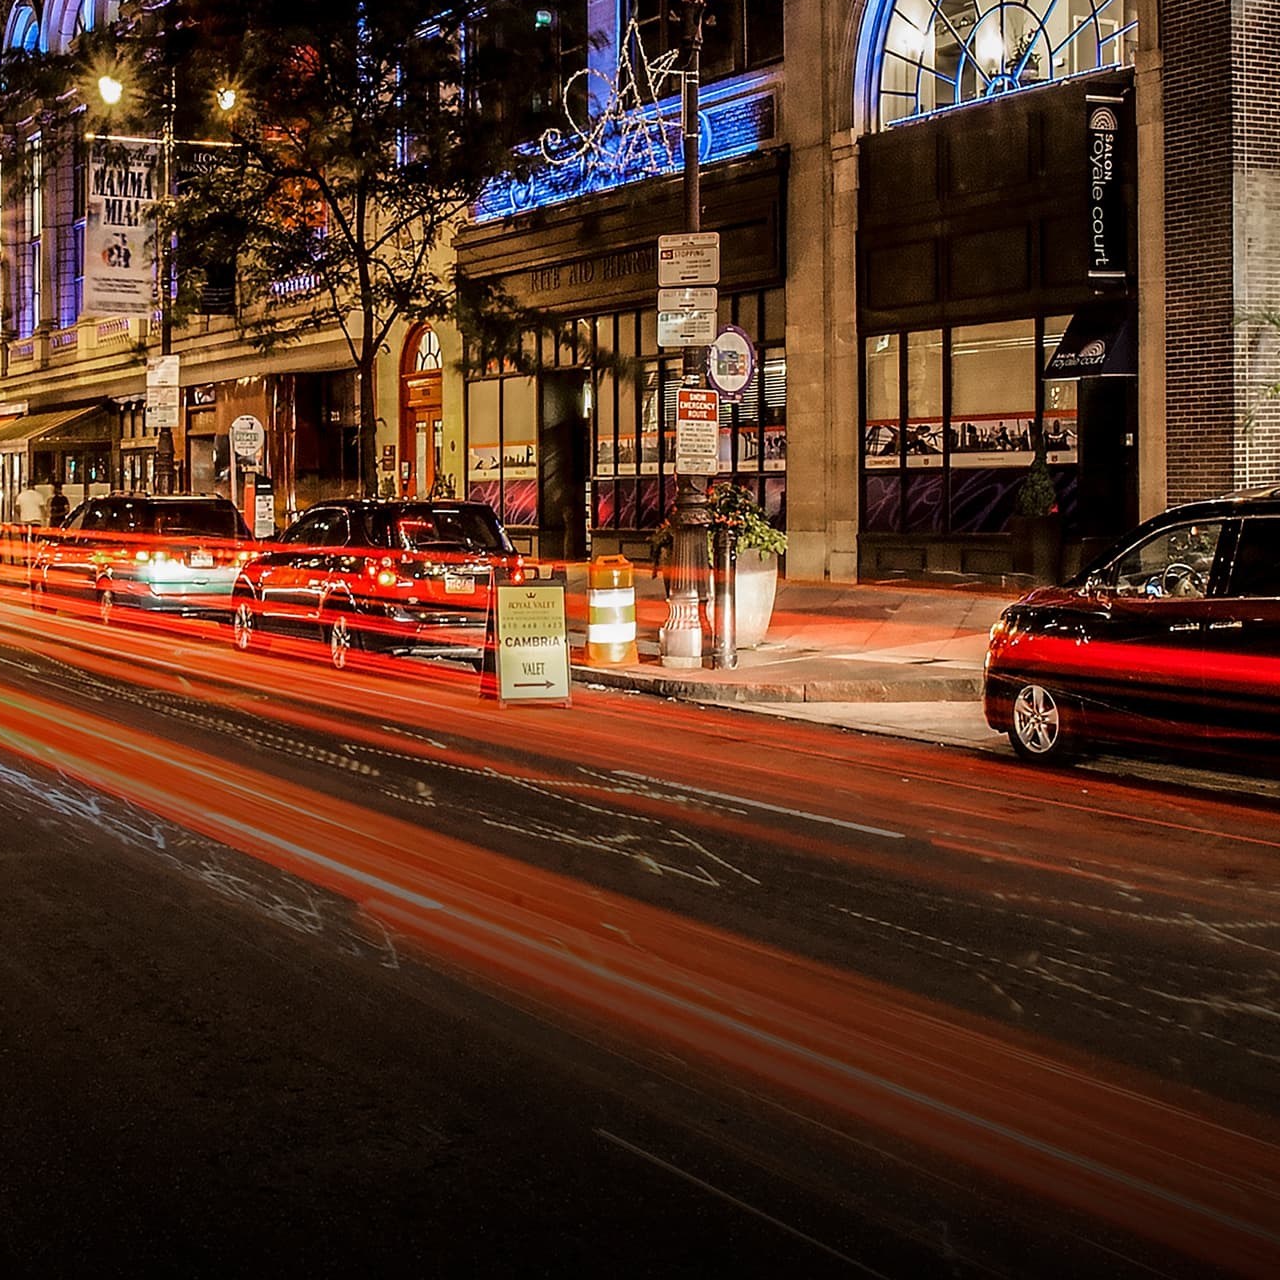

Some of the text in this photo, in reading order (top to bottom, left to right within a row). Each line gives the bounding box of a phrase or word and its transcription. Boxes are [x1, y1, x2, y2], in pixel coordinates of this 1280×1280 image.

[1103, 132, 1115, 181] SALON
[91, 167, 154, 200] MAMMA
[1090, 131, 1109, 265] royale court
[103, 198, 142, 228] MIA!
[679, 401, 716, 411] EMERGENCY
[521, 662, 546, 676] VALET
